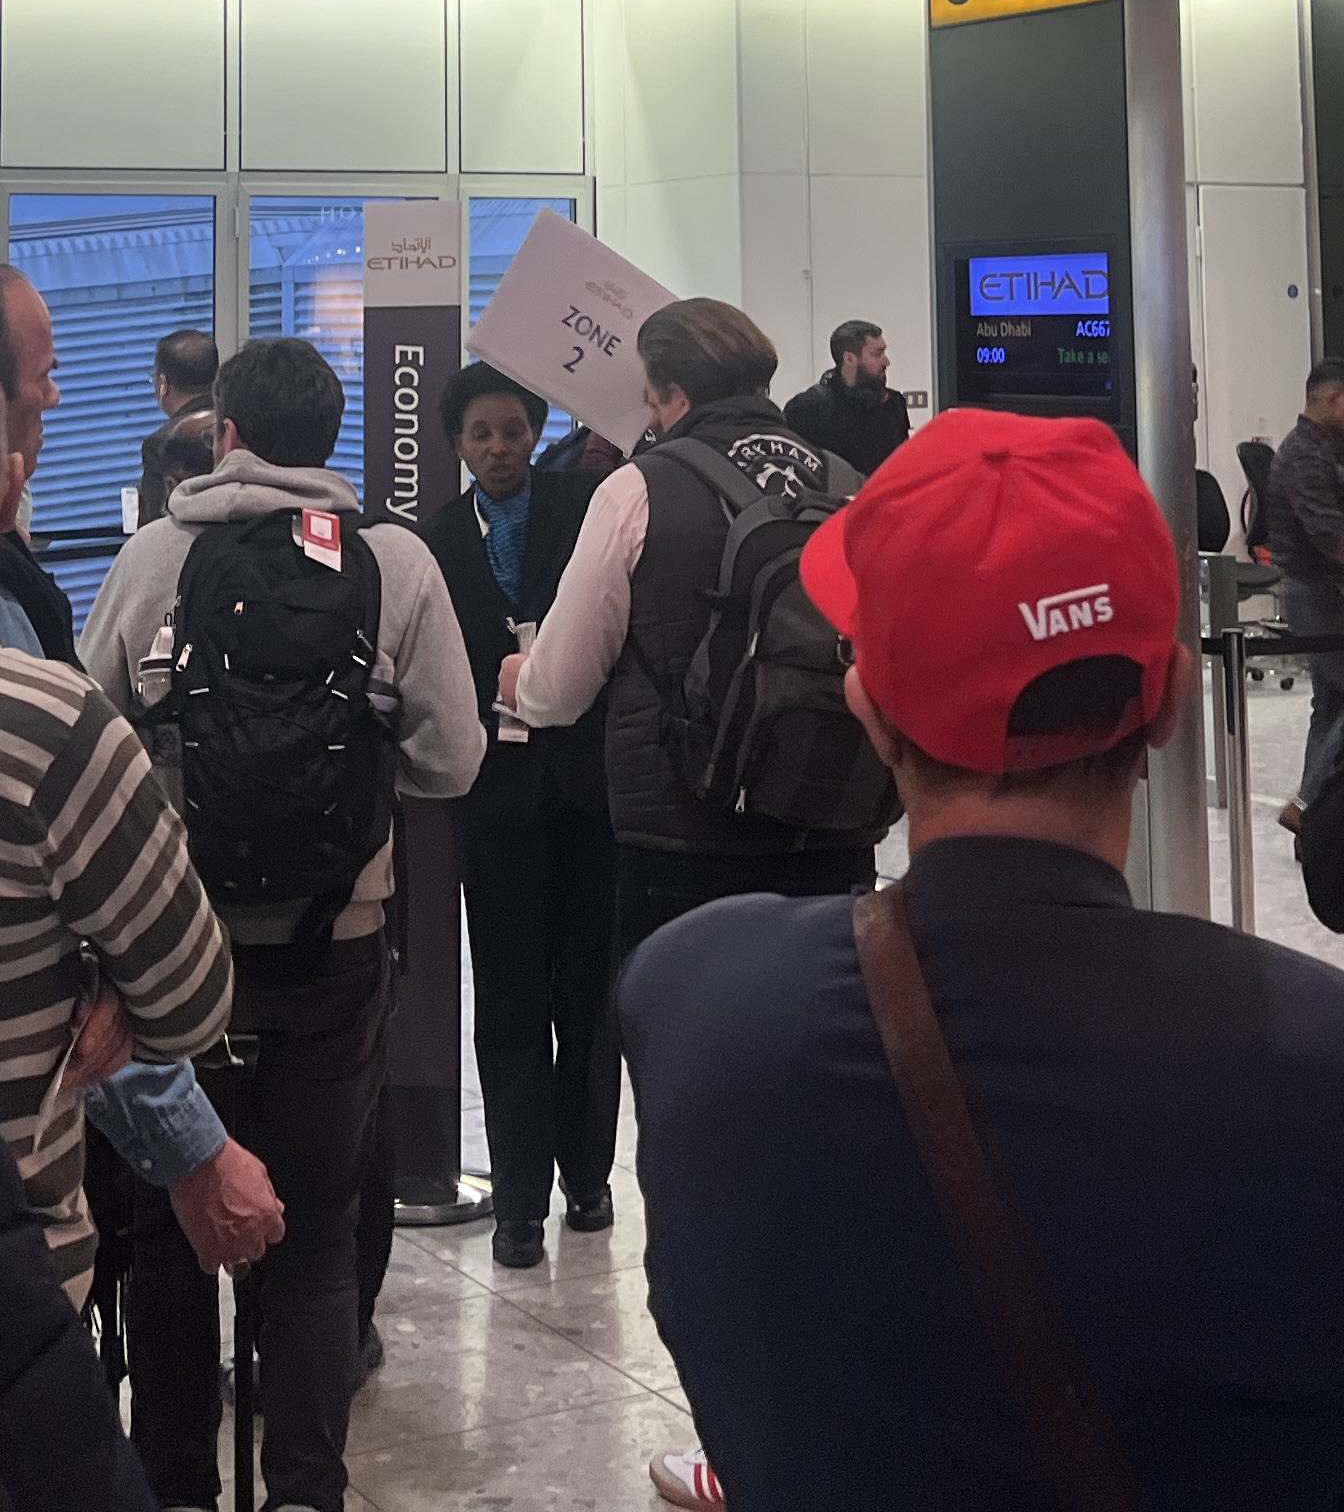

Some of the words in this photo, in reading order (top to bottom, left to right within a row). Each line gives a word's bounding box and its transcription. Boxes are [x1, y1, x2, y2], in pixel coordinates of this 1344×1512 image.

[367, 255, 456, 270] ETIHAD
[979, 270, 1109, 302] ETIHAD
[561, 304, 621, 357] ZONE
[976, 321, 997, 337] Abu
[1000, 320, 1032, 337] Dhabi
[562, 346, 585, 373] 2
[976, 347, 1005, 363] 09:00
[1058, 348, 1085, 364] Take
[1087, 352, 1094, 364] a
[386, 344, 425, 522] Economy
[1018, 583, 1114, 641] VANS
